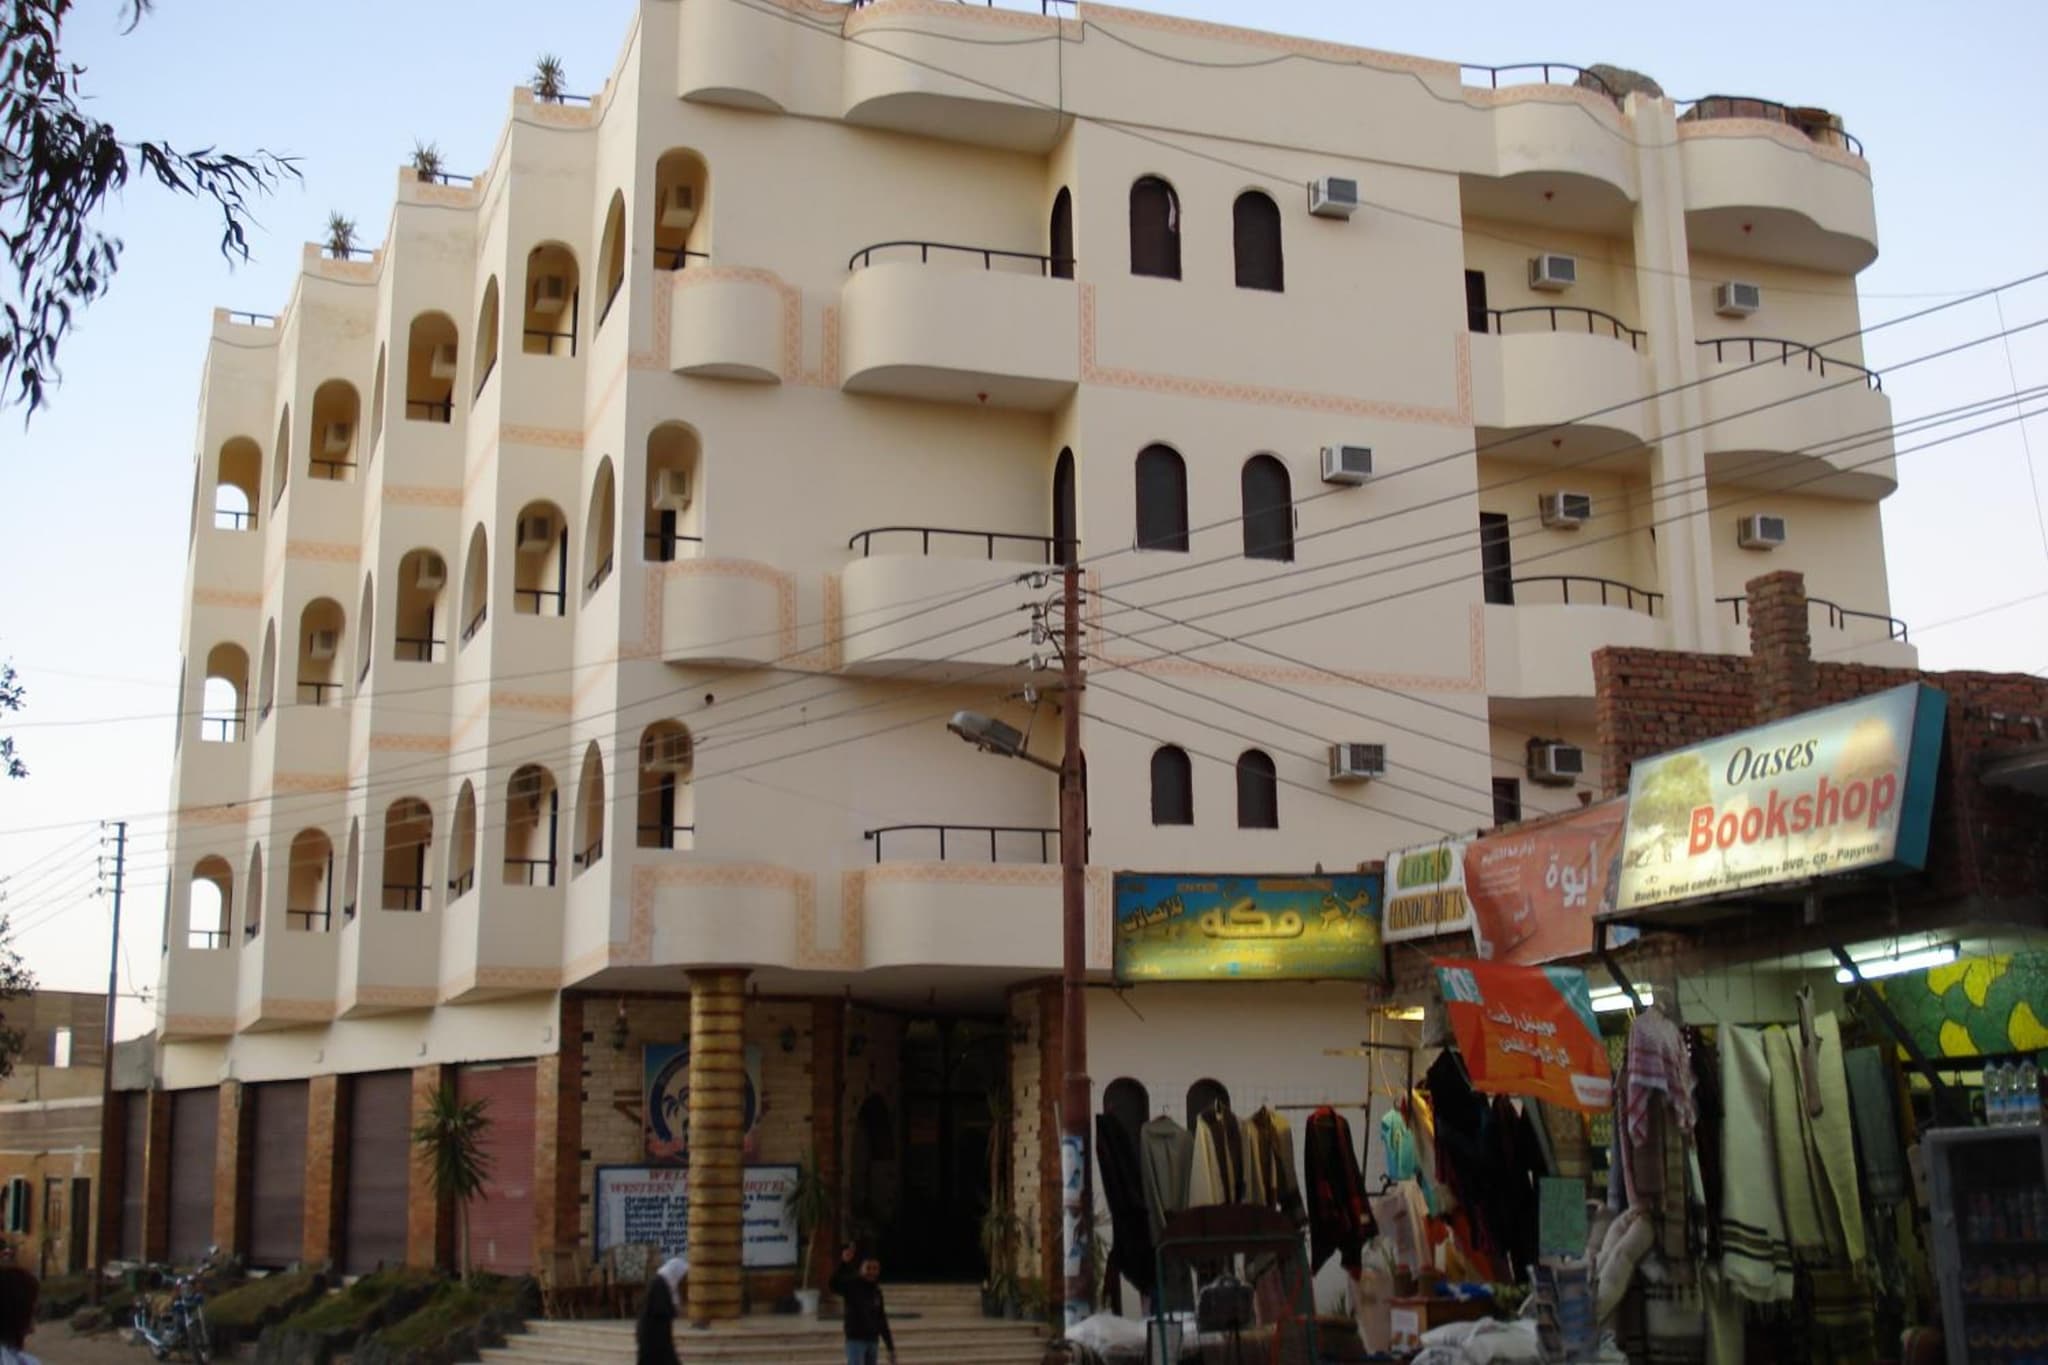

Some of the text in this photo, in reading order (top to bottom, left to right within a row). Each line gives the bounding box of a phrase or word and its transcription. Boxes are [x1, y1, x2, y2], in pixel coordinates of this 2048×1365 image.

[1727, 737, 1818, 786] Oases
[1688, 771, 1897, 857] Bookshop
[1634, 889, 1661, 902] Books
[1669, 882, 1689, 896] Post
[1691, 877, 1717, 892] cards
[1782, 859, 1803, 873] DVD
[1813, 853, 1827, 865] CD
[1837, 843, 1880, 861] Papyrus
[1389, 888, 1465, 929] HANDICRAFTS
[610, 1182, 674, 1193] WESTERN
